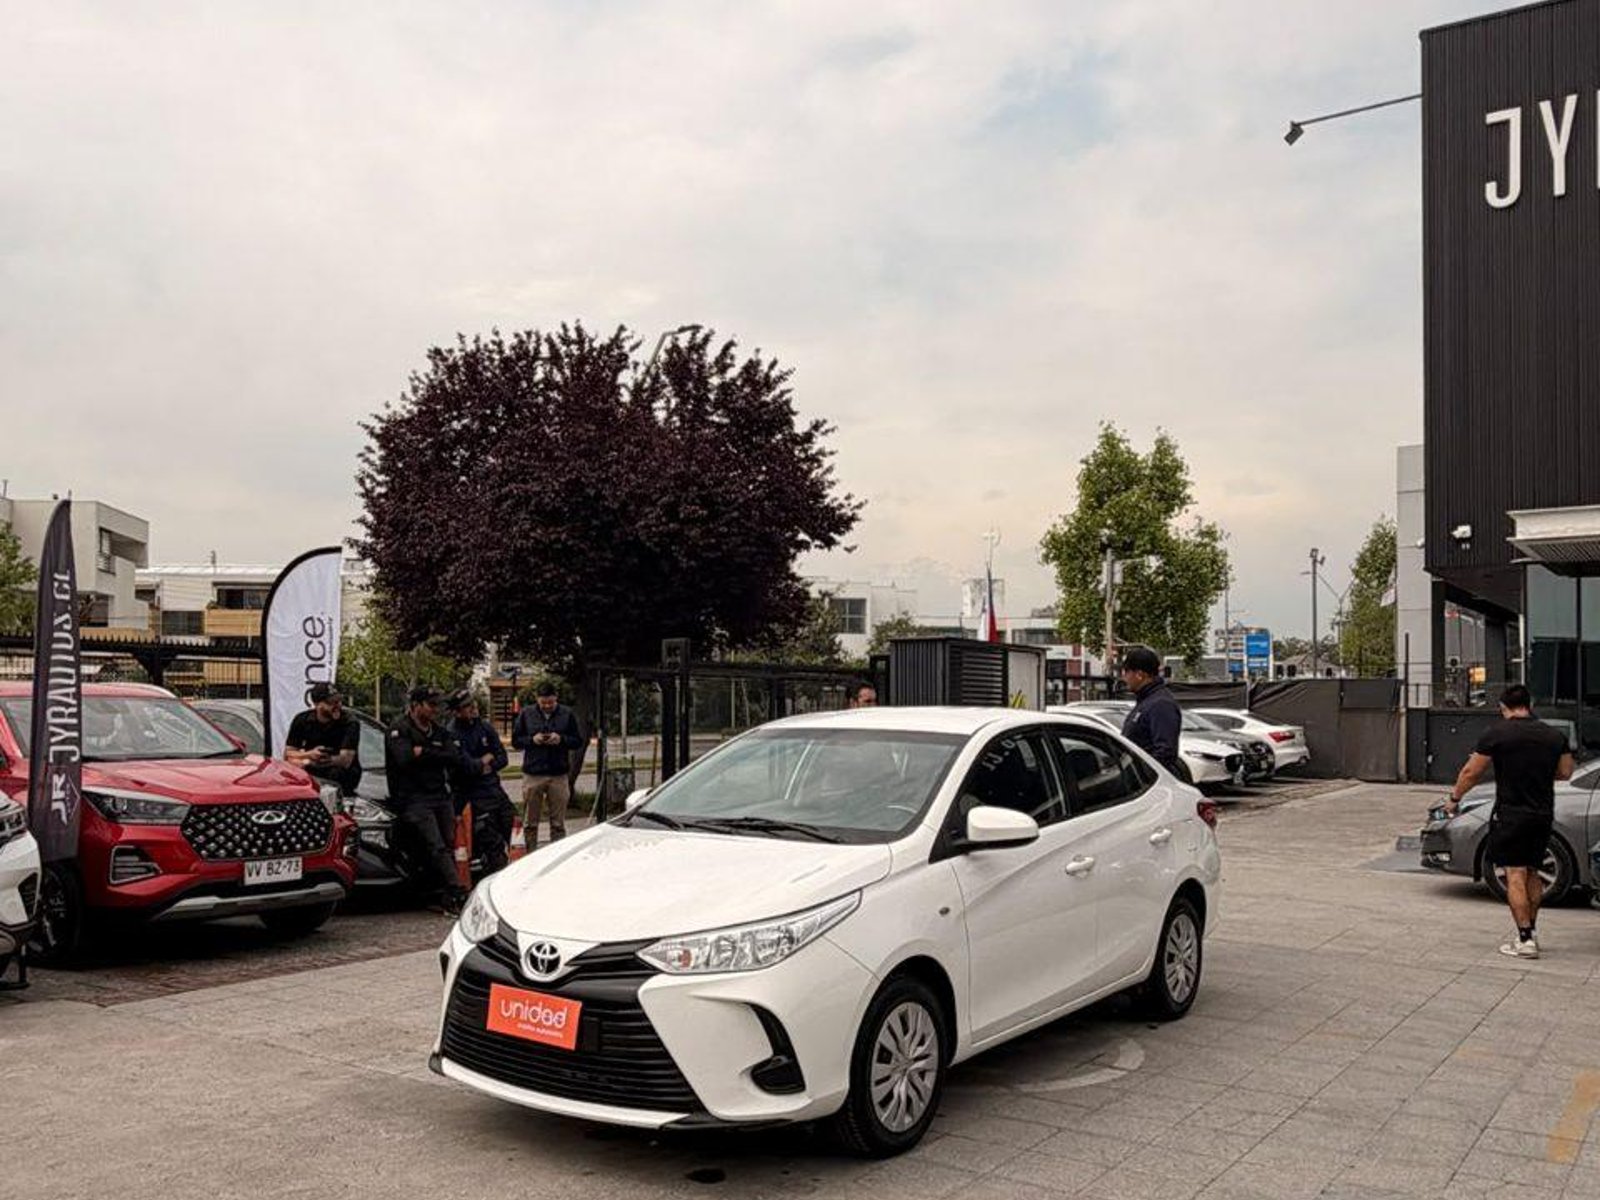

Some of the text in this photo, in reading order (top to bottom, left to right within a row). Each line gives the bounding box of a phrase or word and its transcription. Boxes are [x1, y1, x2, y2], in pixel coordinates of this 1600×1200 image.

[1485, 90, 1600, 208] JY
[52, 774, 68, 826] JR
[501, 999, 567, 1029] unidad
